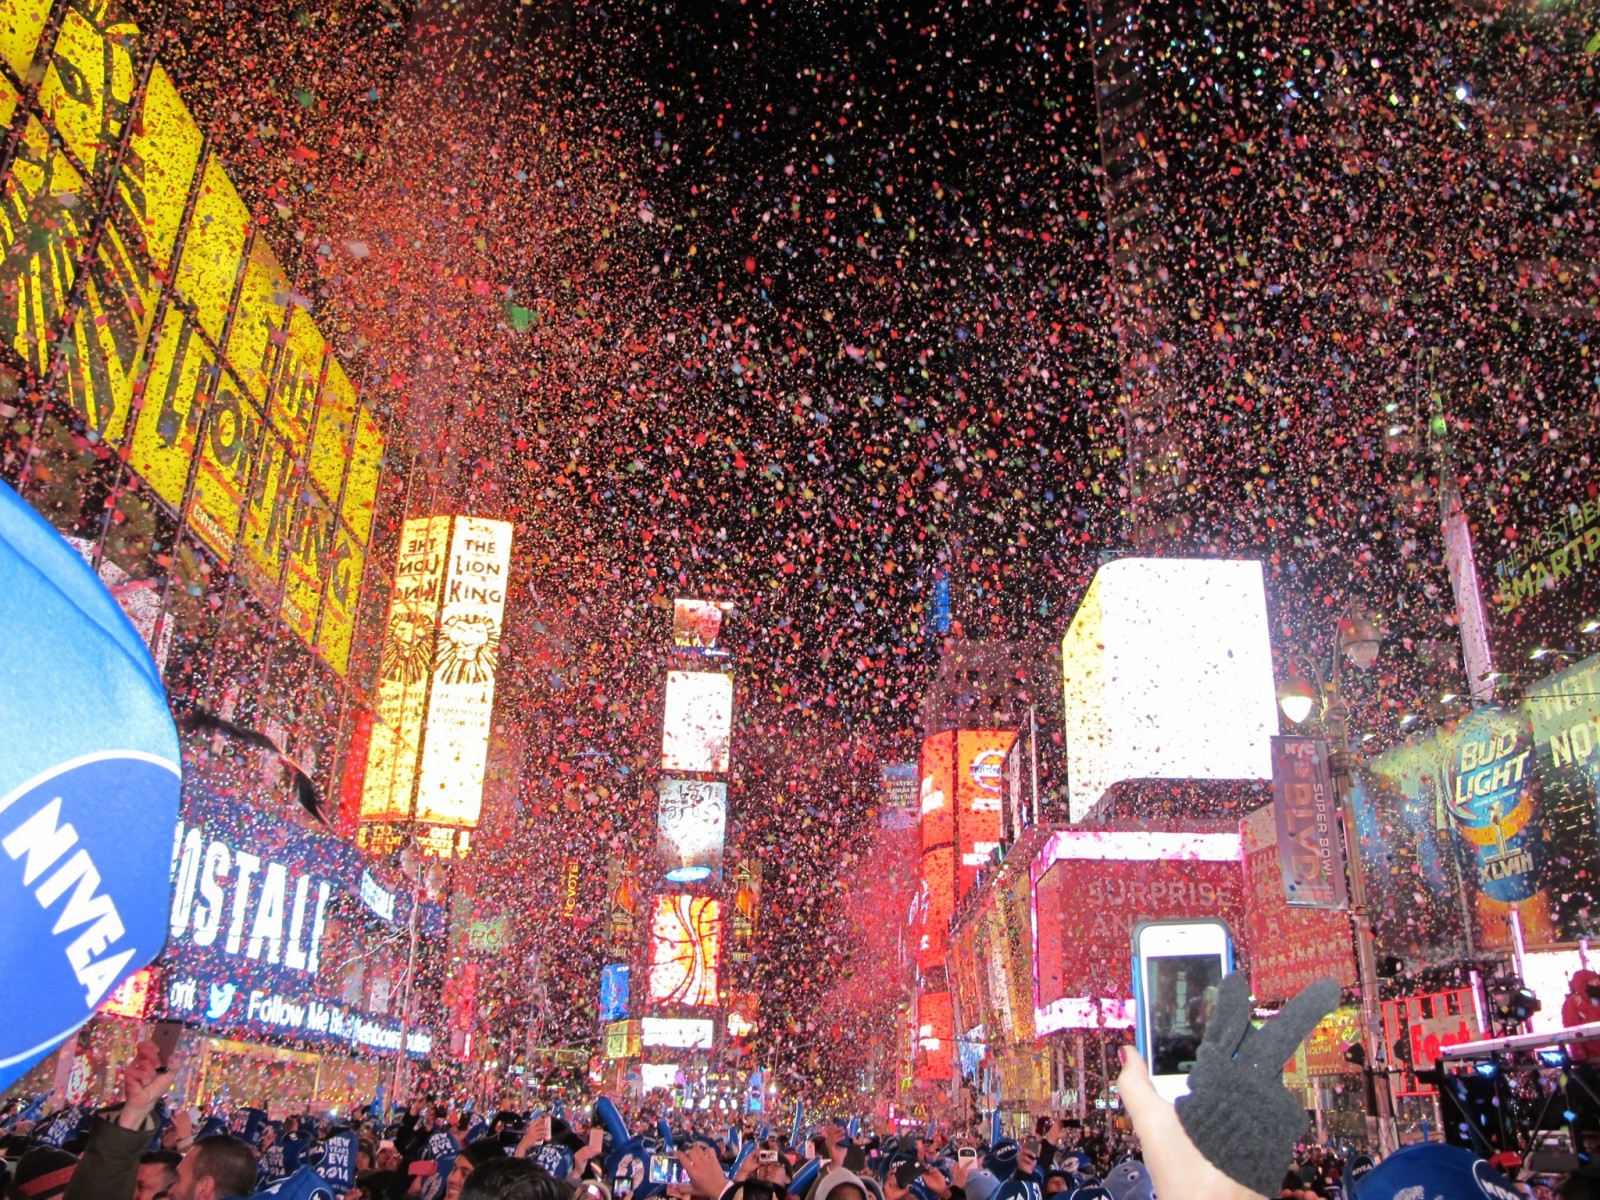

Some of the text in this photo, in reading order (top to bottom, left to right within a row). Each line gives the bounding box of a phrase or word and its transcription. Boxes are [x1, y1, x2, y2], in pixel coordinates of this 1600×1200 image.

[1569, 495, 1600, 533] BE
[456, 554, 500, 575] LION
[464, 539, 496, 553] THE
[448, 578, 502, 603] KING
[1461, 728, 1518, 775] BUD
[1455, 750, 1530, 804] LIGHT
[1313, 783, 1328, 833] SUPER
[1284, 783, 1320, 880] BLVD
[2, 797, 137, 1009] NIVEA
[1088, 879, 1233, 908] SURPRISE
[247, 990, 304, 1028] Follow
[328, 1136, 350, 1147] NEW
[328, 1153, 349, 1167] EVE
